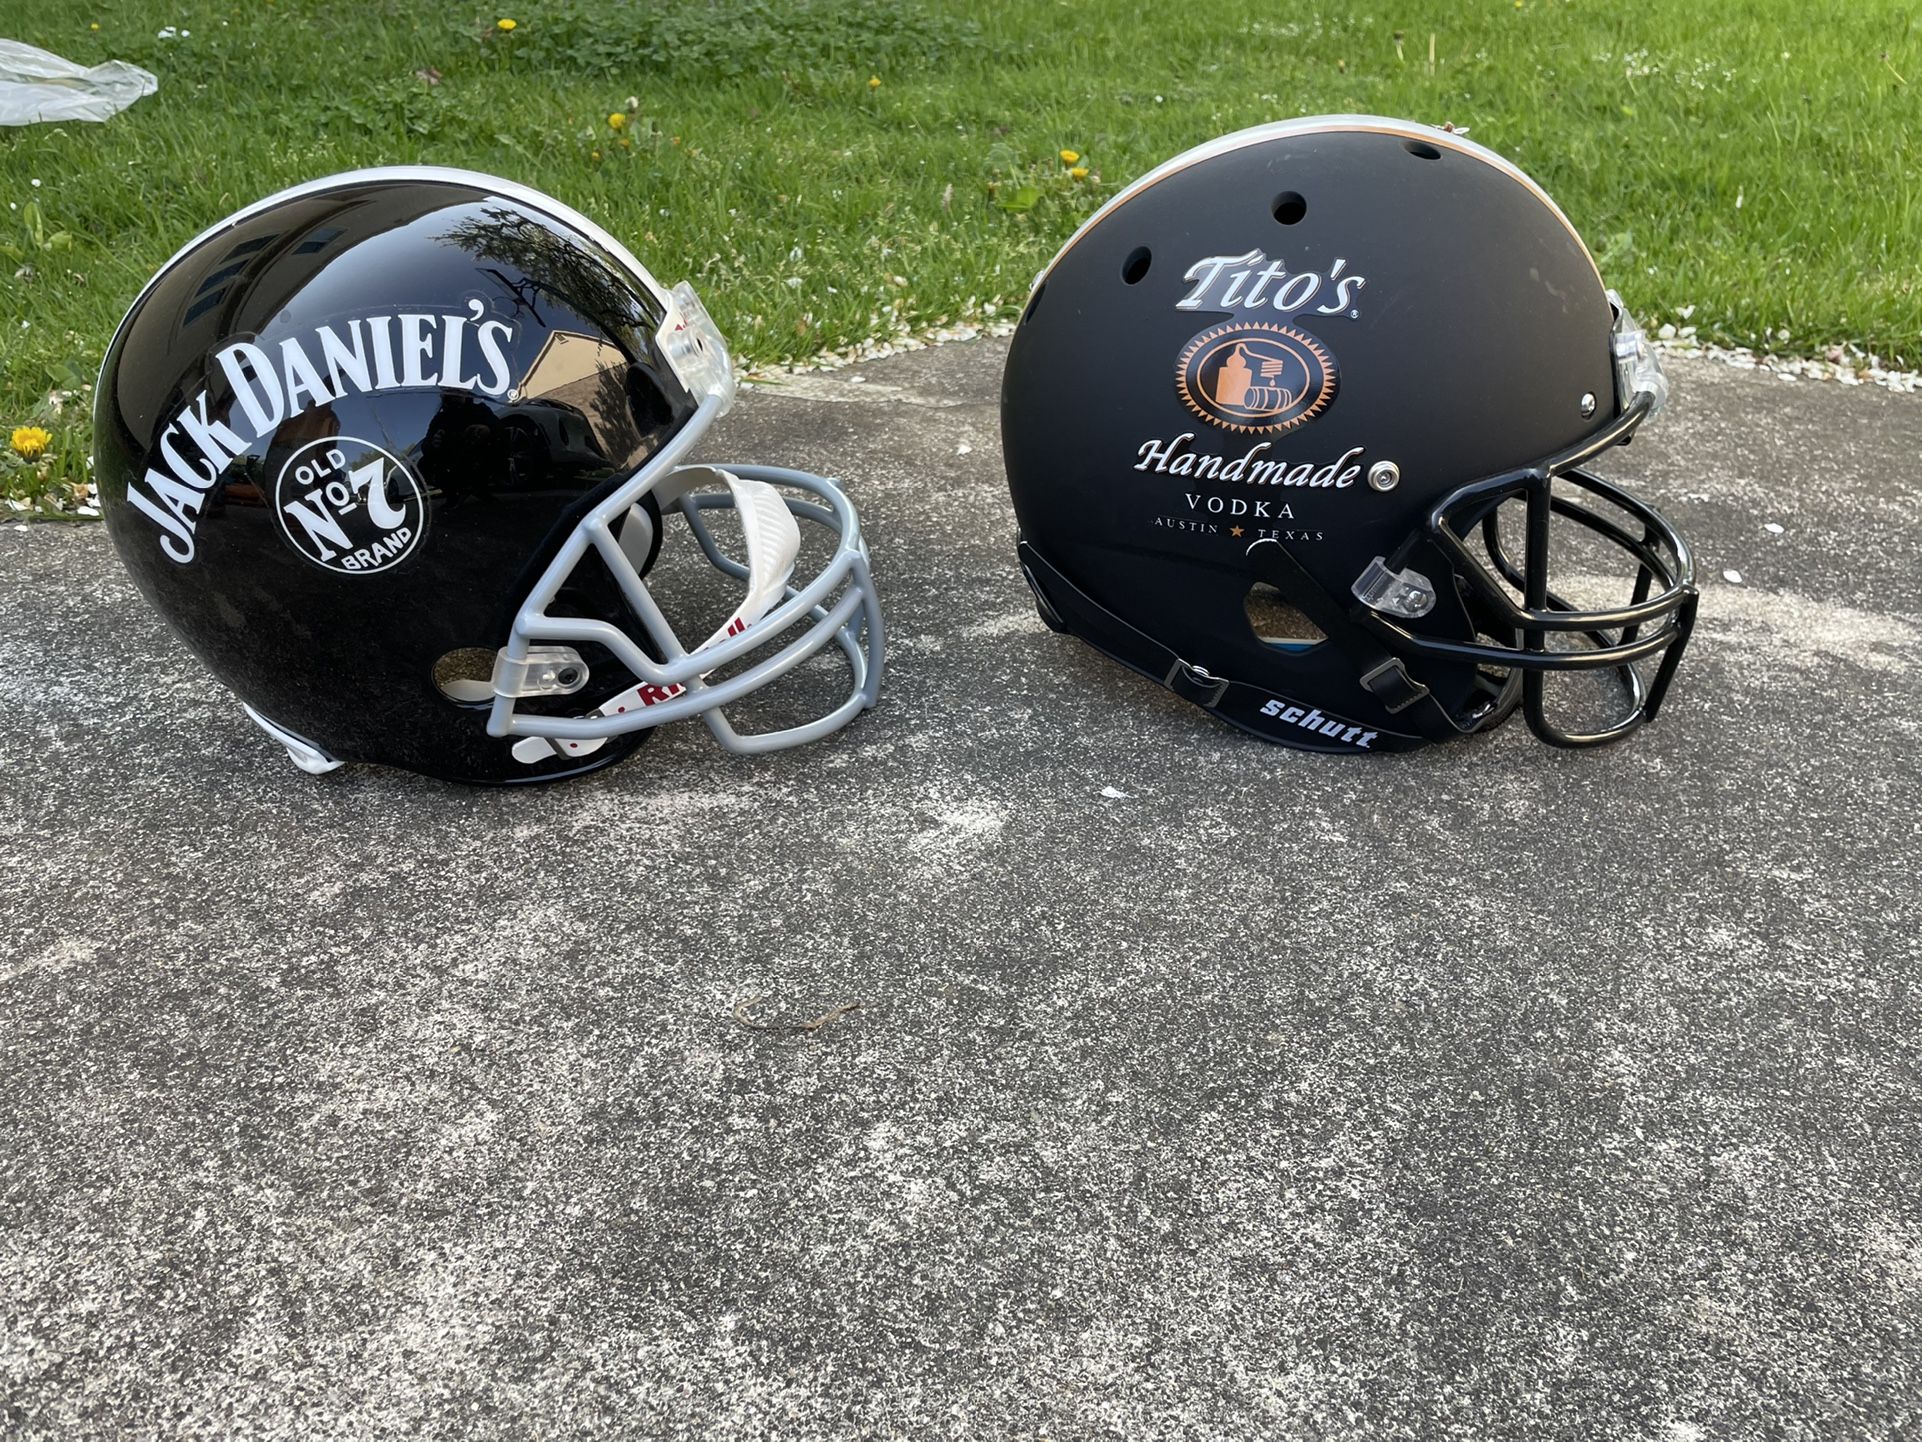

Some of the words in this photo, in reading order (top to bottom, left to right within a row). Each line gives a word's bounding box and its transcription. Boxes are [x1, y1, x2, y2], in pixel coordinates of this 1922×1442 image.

[1175, 248, 1366, 314] Tito's
[127, 390, 252, 564] JACK
[214, 299, 513, 438] DANIEL'S
[295, 449, 346, 485] OLD
[1133, 432, 1365, 489] Handmade
[1154, 517, 1219, 534] AUSTIN
[1257, 528, 1324, 541] TEXAS
[1185, 493, 1294, 519] VODKA
[341, 527, 411, 570] BRAND
[1260, 699, 1378, 748] schutt
